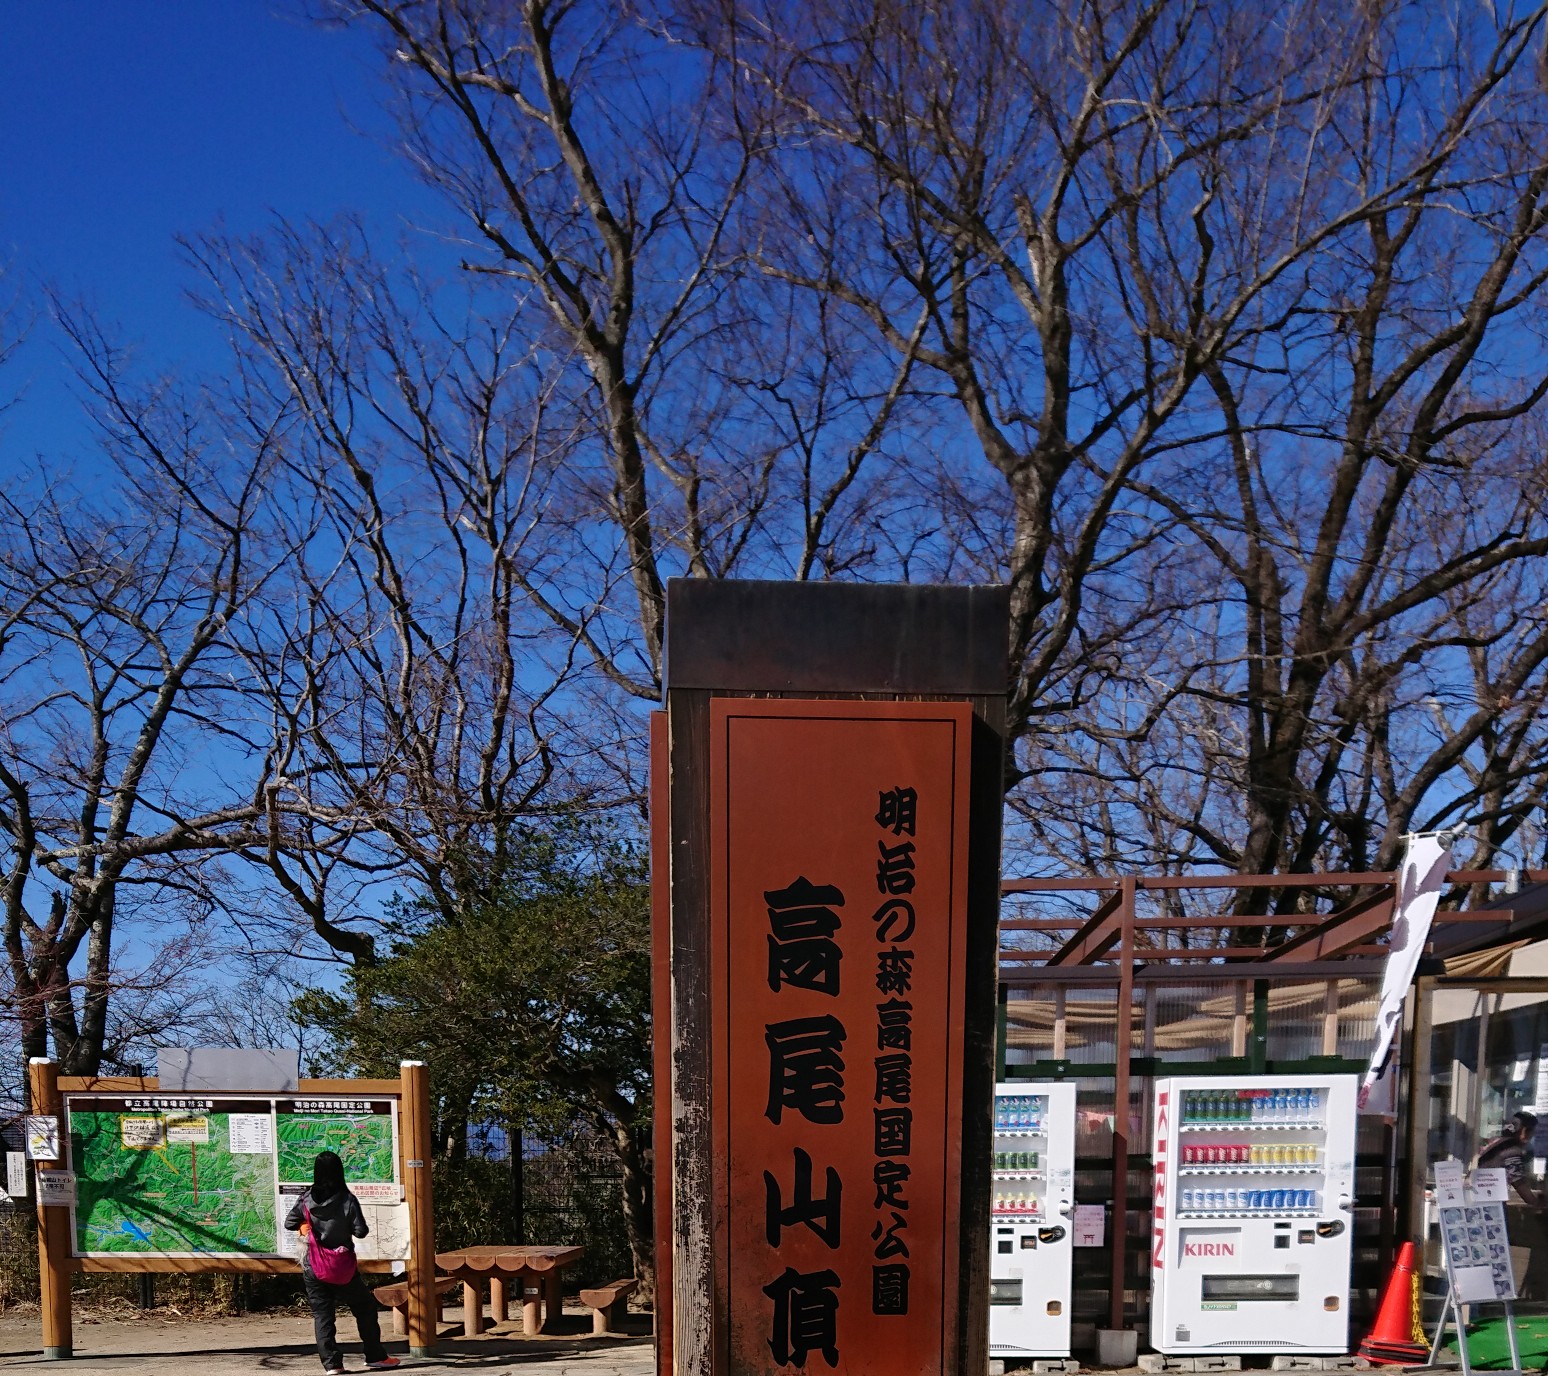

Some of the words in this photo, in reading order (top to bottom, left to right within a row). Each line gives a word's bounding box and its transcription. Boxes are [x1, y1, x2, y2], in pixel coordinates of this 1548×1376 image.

[294, 1101, 371, 1109] 明治の森高尾国定公園
[764, 875, 847, 1368] 高尾山頂
[872, 786, 917, 1316] 明治の森高尾国定公園
[1153, 1092, 1169, 1269] KIRIN
[1184, 1243, 1235, 1257] KIRIN
